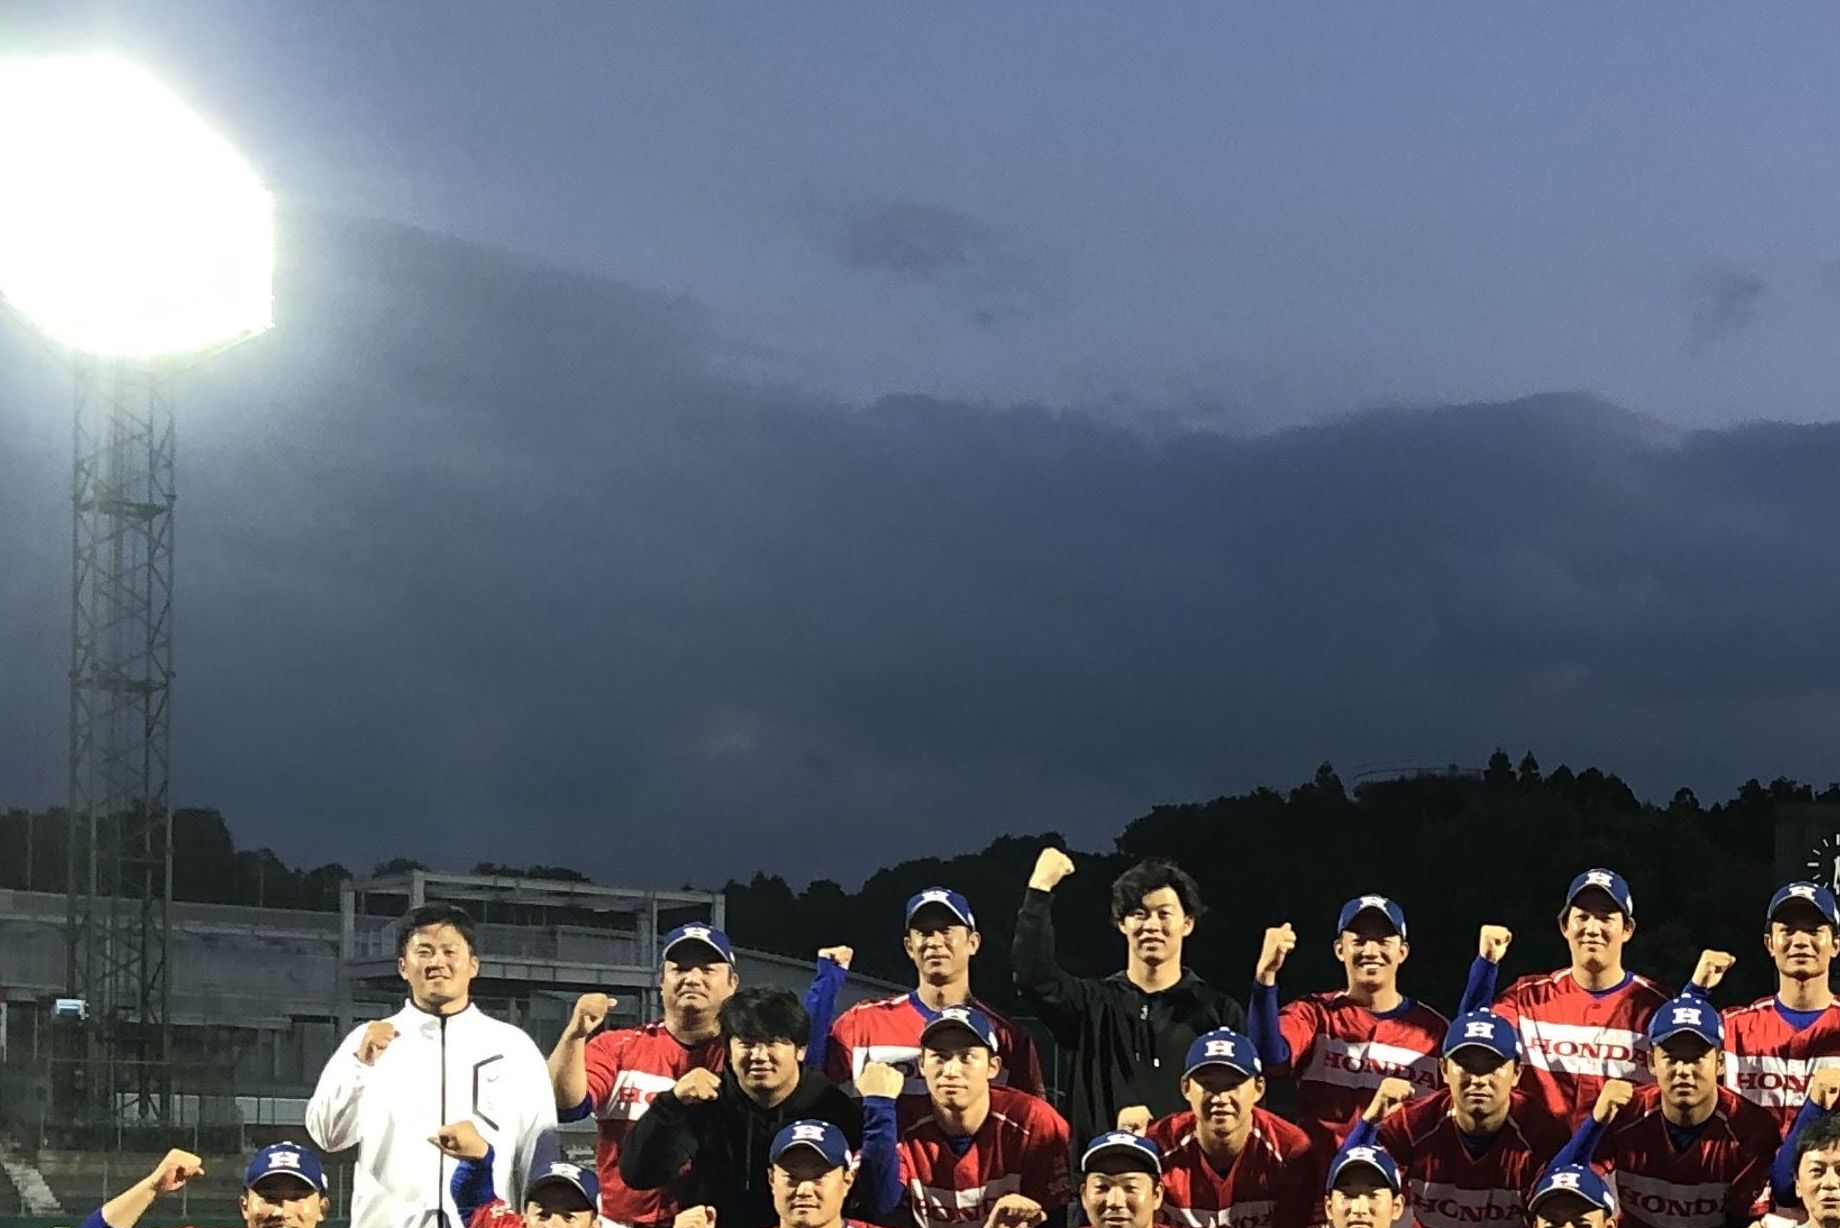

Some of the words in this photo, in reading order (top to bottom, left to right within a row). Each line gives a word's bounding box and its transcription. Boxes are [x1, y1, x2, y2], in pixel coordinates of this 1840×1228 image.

[1672, 1008, 1701, 1025] H
[1464, 1022, 1494, 1039] H
[1205, 1040, 1235, 1057] H
[1324, 1052, 1440, 1088] HONDA
[1736, 1071, 1814, 1092] HON
[792, 1126, 824, 1141] H
[269, 1151, 300, 1168] H
[1621, 1190, 1727, 1217] HOND
